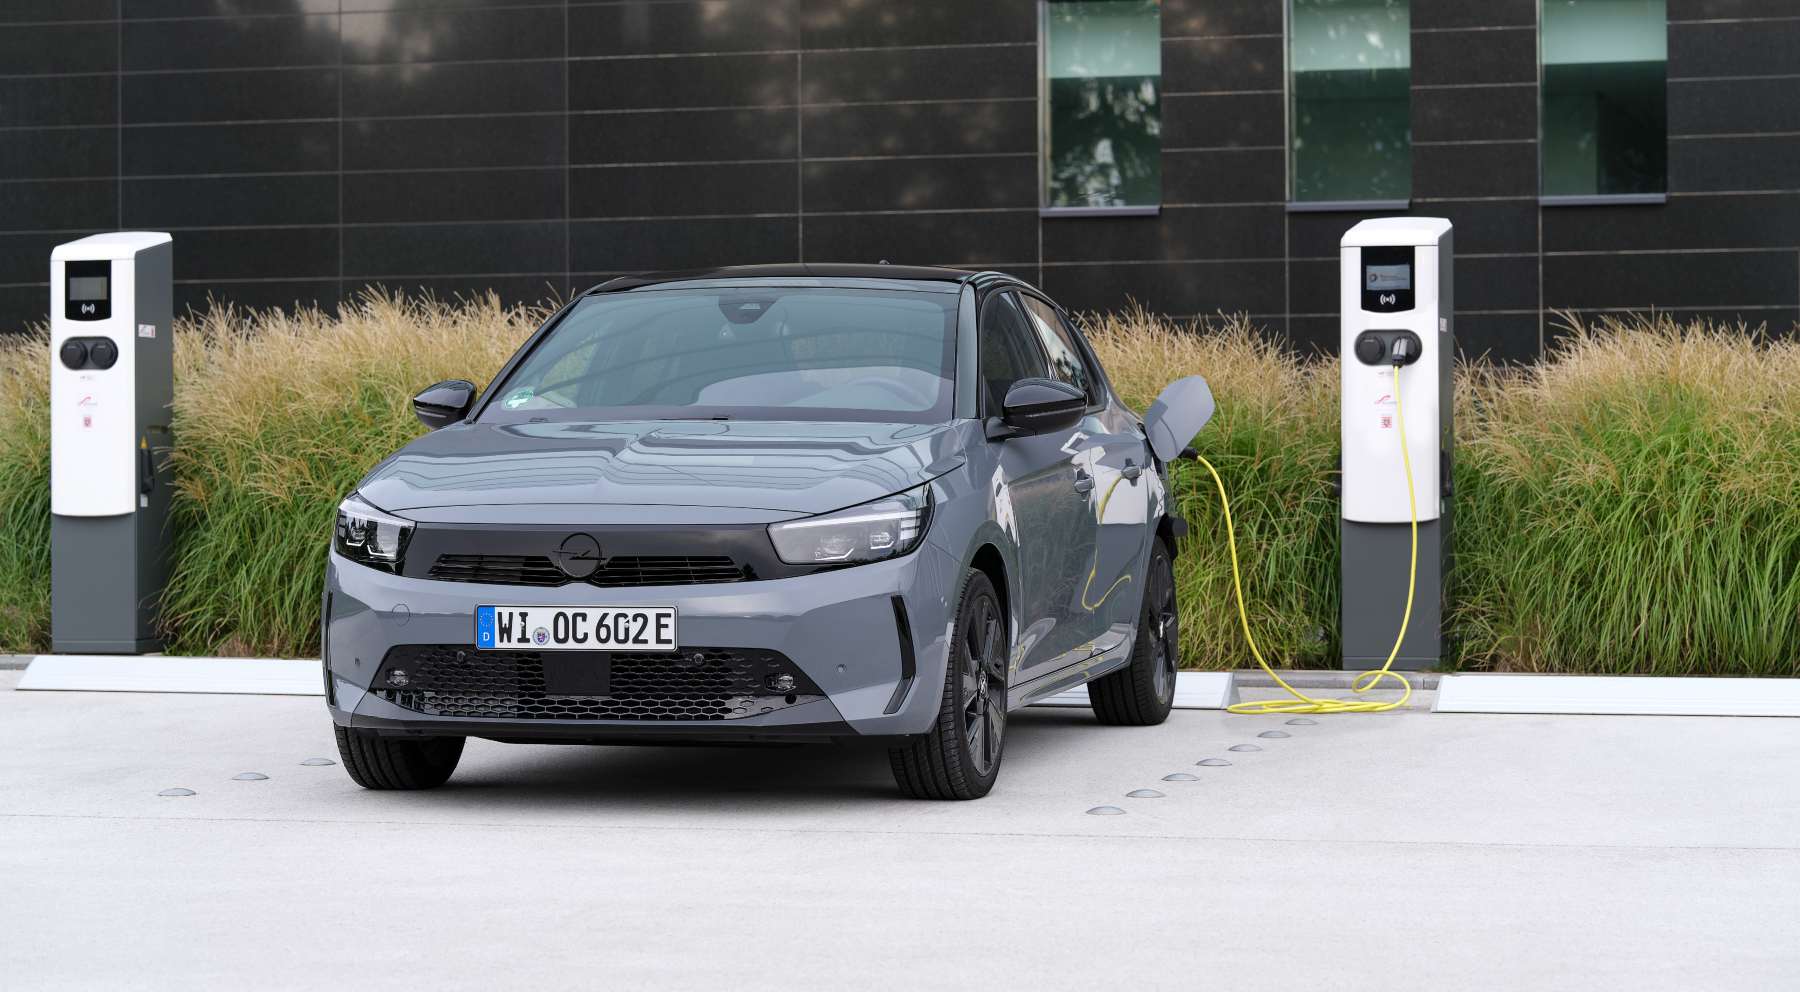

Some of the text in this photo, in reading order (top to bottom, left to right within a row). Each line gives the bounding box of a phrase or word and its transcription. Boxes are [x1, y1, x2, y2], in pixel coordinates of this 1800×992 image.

[483, 632, 490, 641] D
[497, 612, 530, 643] WI
[553, 612, 588, 644] OC
